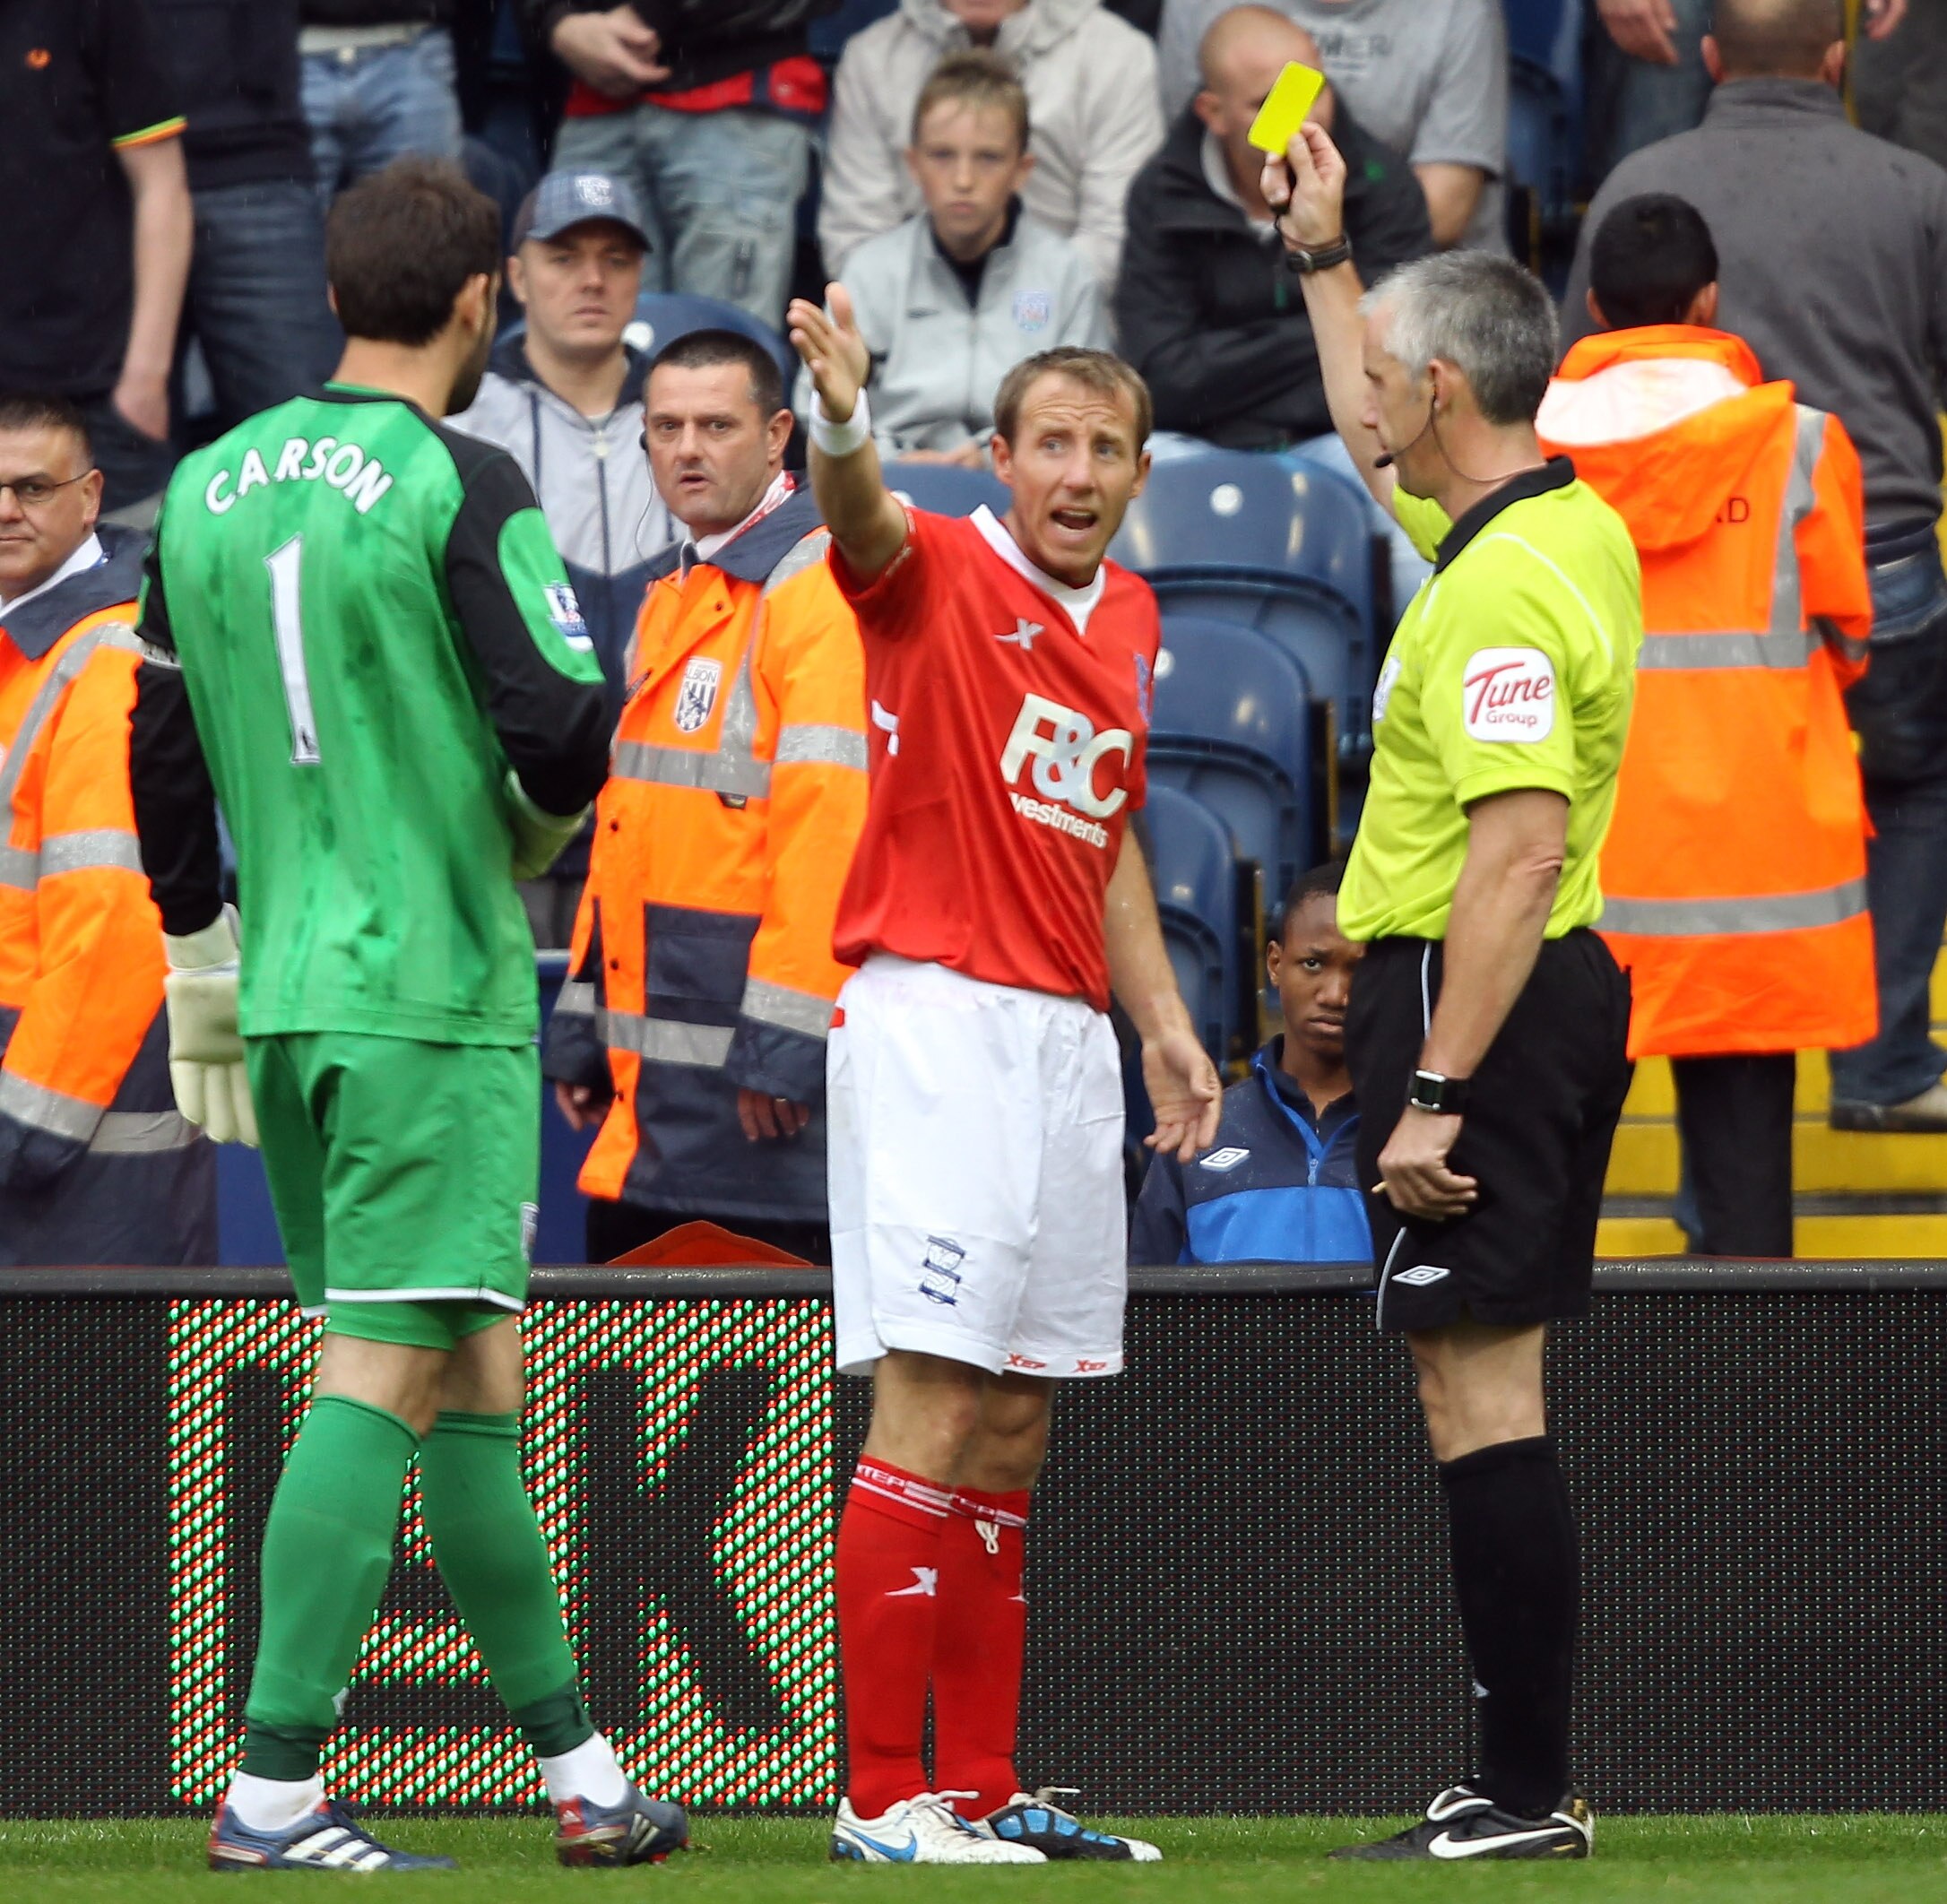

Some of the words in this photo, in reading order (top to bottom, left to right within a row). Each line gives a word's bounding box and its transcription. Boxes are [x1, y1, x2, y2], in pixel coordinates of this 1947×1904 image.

[205, 436, 394, 515] CARSON
[264, 532, 321, 767] 1
[1464, 662, 1553, 724] Tune
[1486, 710, 1537, 729] Group
[999, 692, 1134, 818] F&C
[1008, 791, 1109, 849] vestments
